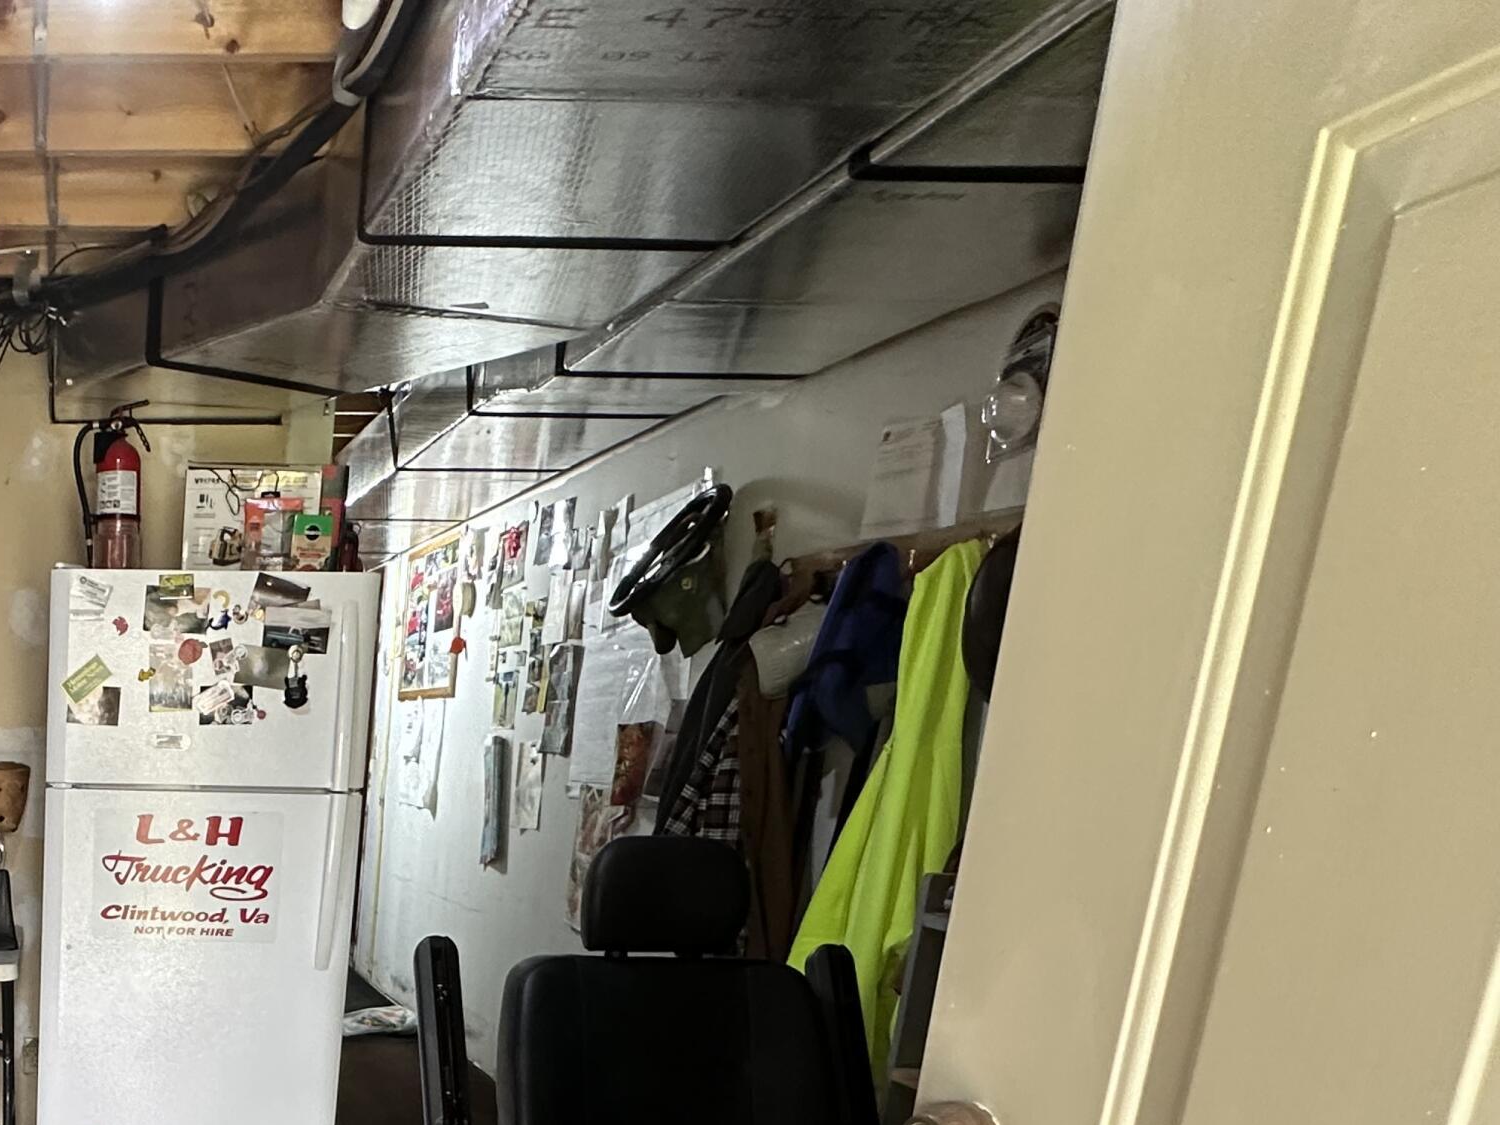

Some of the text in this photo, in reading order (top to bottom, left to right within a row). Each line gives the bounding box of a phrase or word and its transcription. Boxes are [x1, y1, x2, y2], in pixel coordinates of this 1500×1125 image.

[135, 813, 244, 847] L & H
[101, 850, 274, 901] Trucking
[100, 904, 270, 924] Clintwood, Va
[133, 925, 235, 937] NOT FOR HIRE
